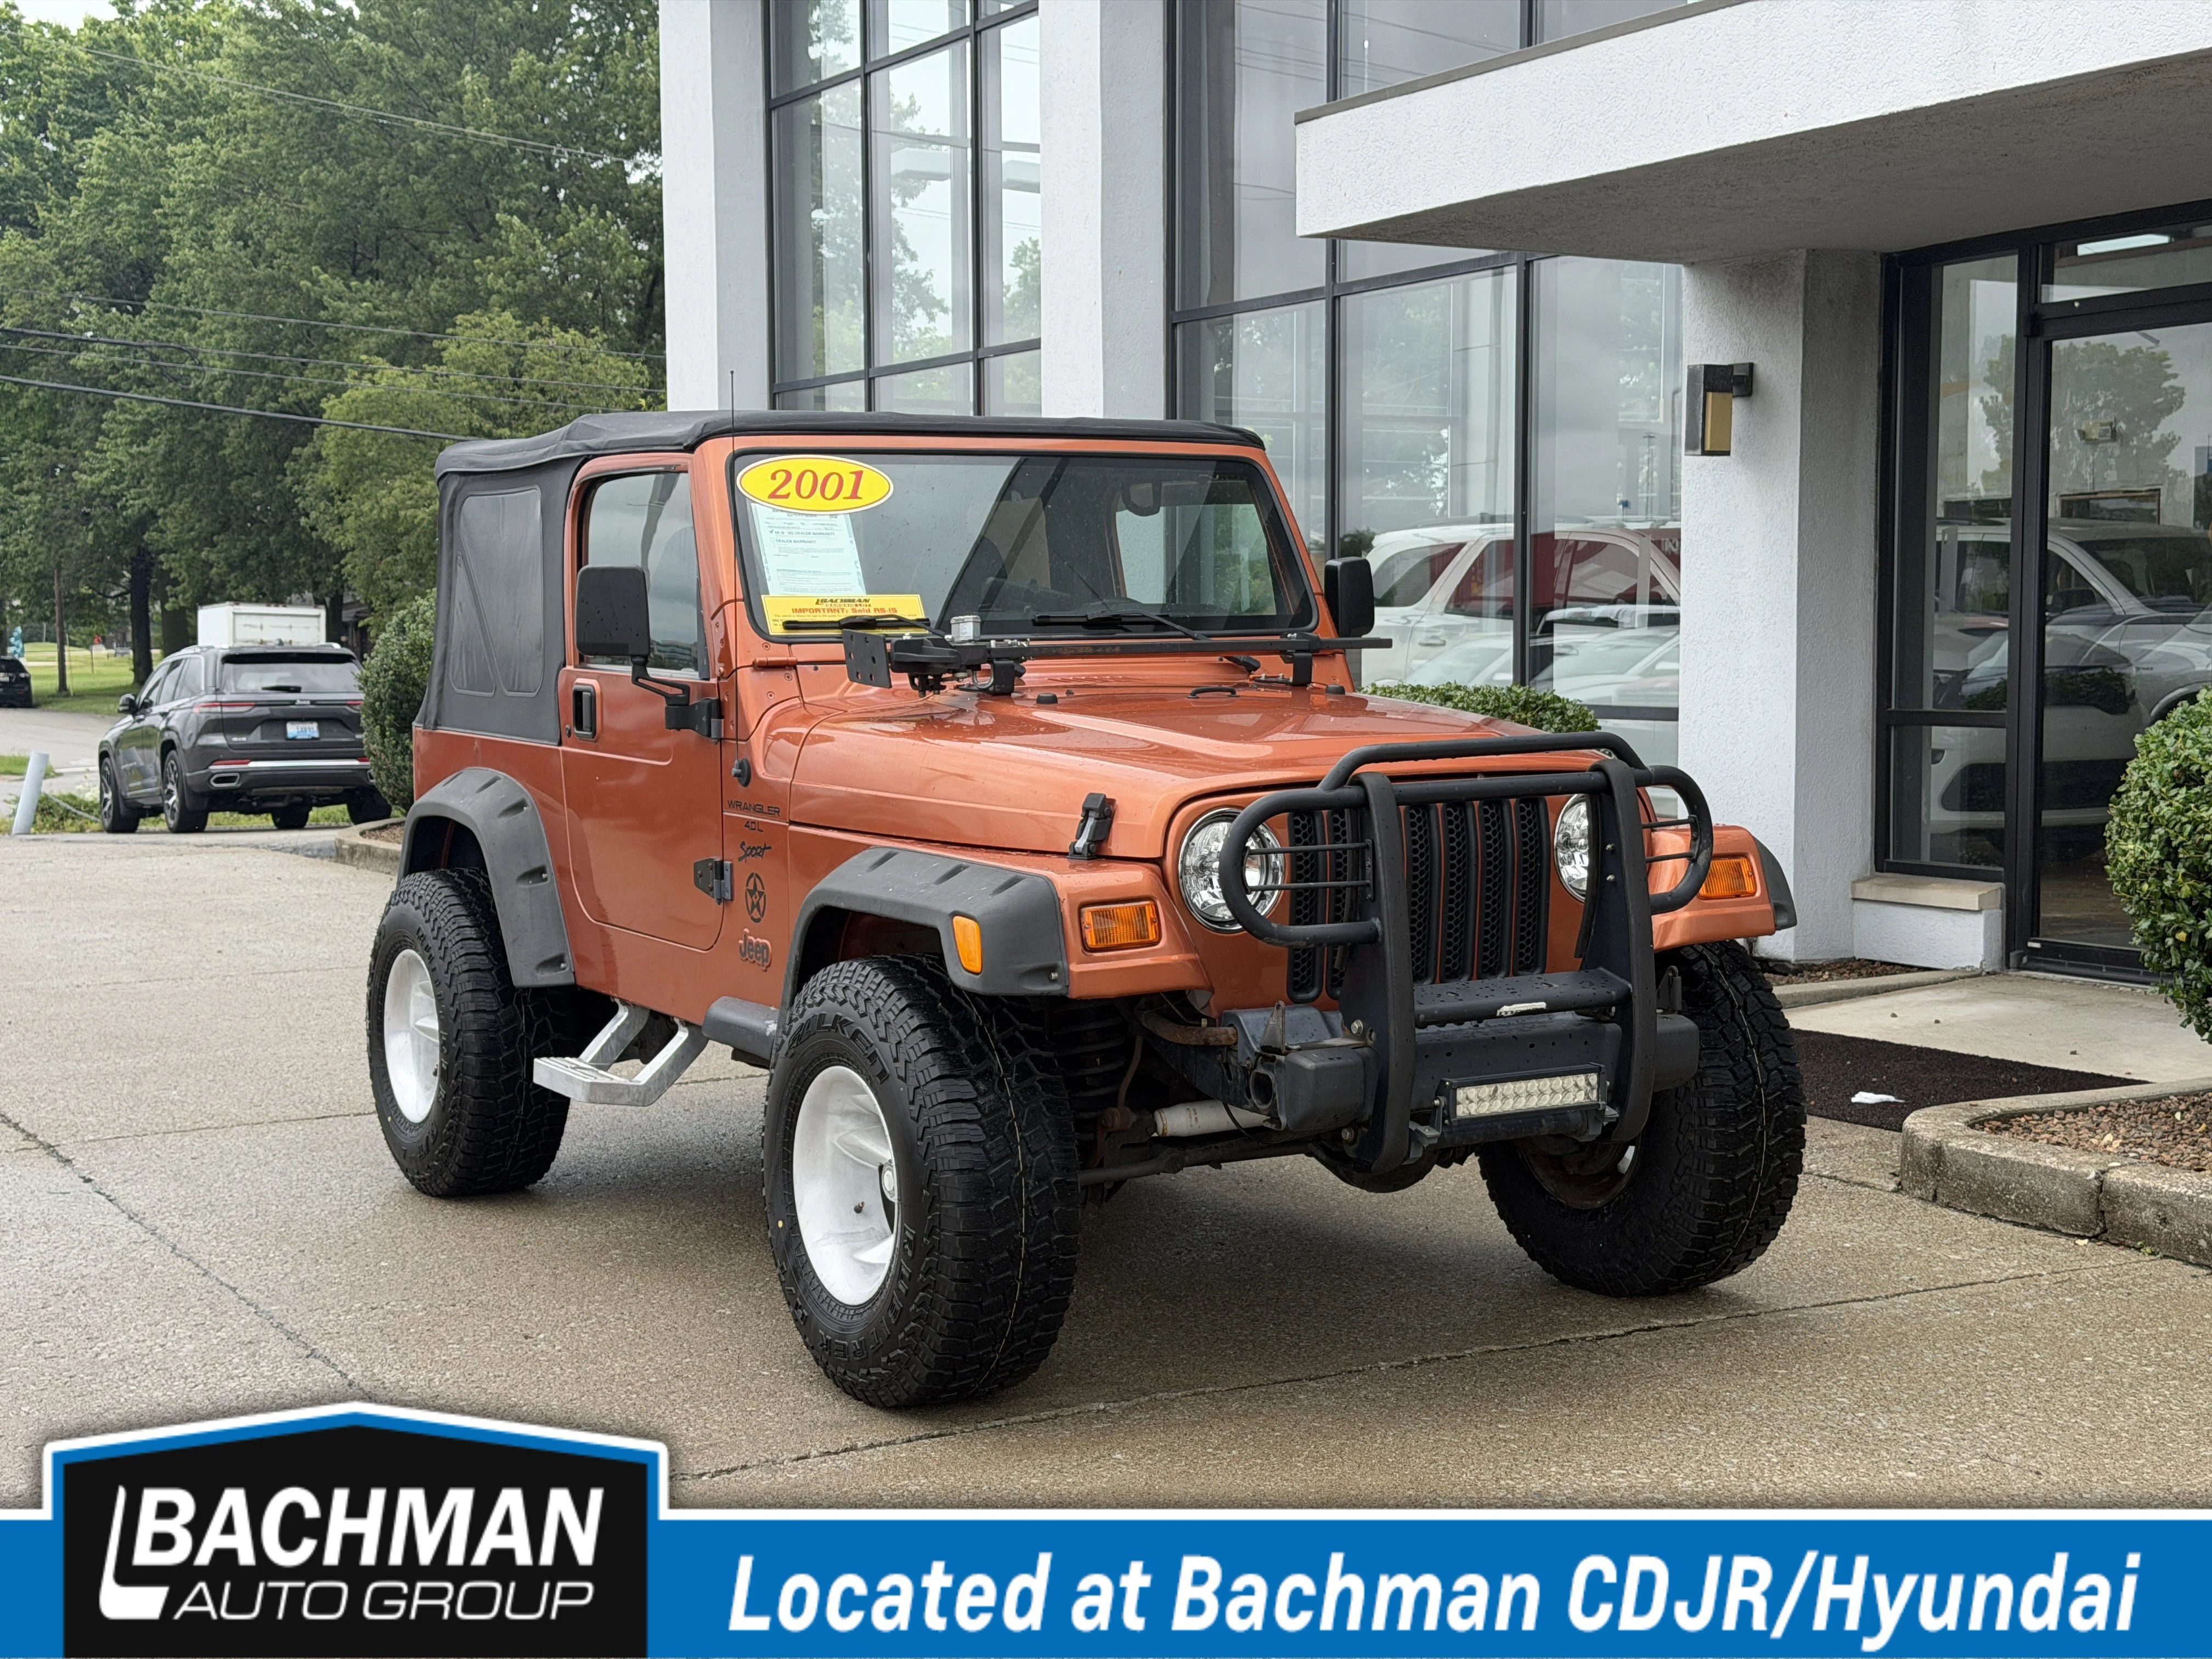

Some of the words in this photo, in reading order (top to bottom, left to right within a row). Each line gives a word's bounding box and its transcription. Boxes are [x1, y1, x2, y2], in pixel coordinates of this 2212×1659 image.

[768, 469, 864, 501] 2001
[727, 799, 781, 816] WRANGLER
[738, 929, 772, 972] Jeep
[785, 1012, 890, 1085] FALKEN
